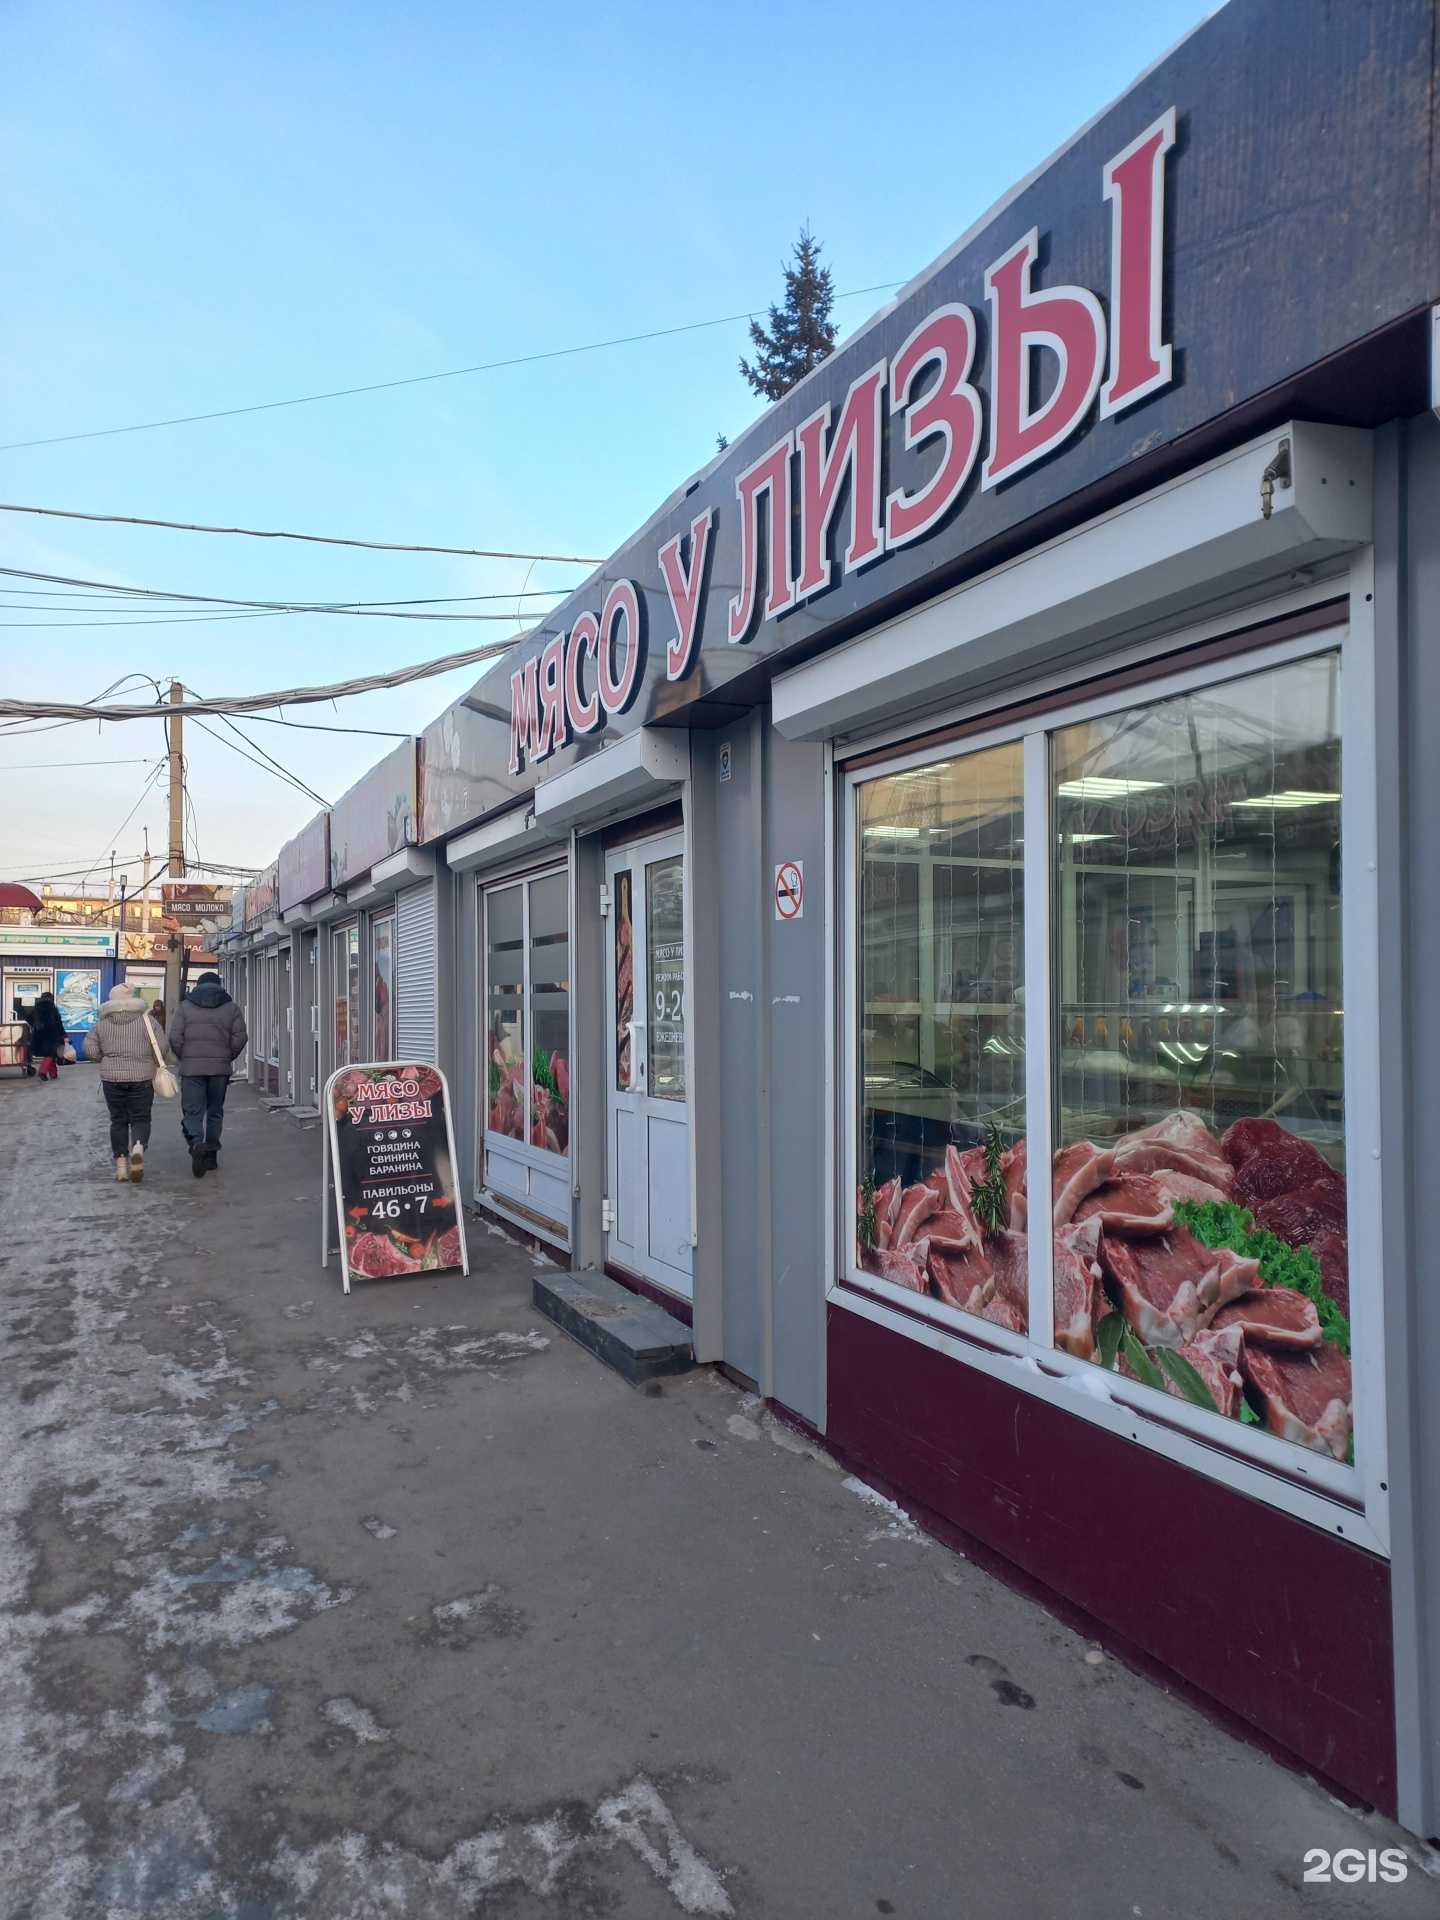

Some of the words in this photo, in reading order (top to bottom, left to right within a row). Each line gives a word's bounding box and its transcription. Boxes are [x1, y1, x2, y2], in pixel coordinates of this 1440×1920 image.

[508, 578, 642, 774] МЯСО
[657, 506, 713, 681] У
[728, 105, 1176, 643] ЛИЗЫ
[171, 903, 191, 912] МЯСО
[195, 903, 224, 912] МОЛОКО
[656, 990, 684, 1021] 9-2
[357, 1080, 420, 1102] МЯСО
[348, 1106, 366, 1124] У
[369, 1100, 433, 1123] ЛИЗЫ
[367, 1141, 421, 1154] ГОВЯДИНА
[371, 1151, 419, 1164] СВИНИНА
[369, 1162, 423, 1175] БАРАНИНА
[362, 1183, 434, 1199] ПАВИЛЬОНЫ
